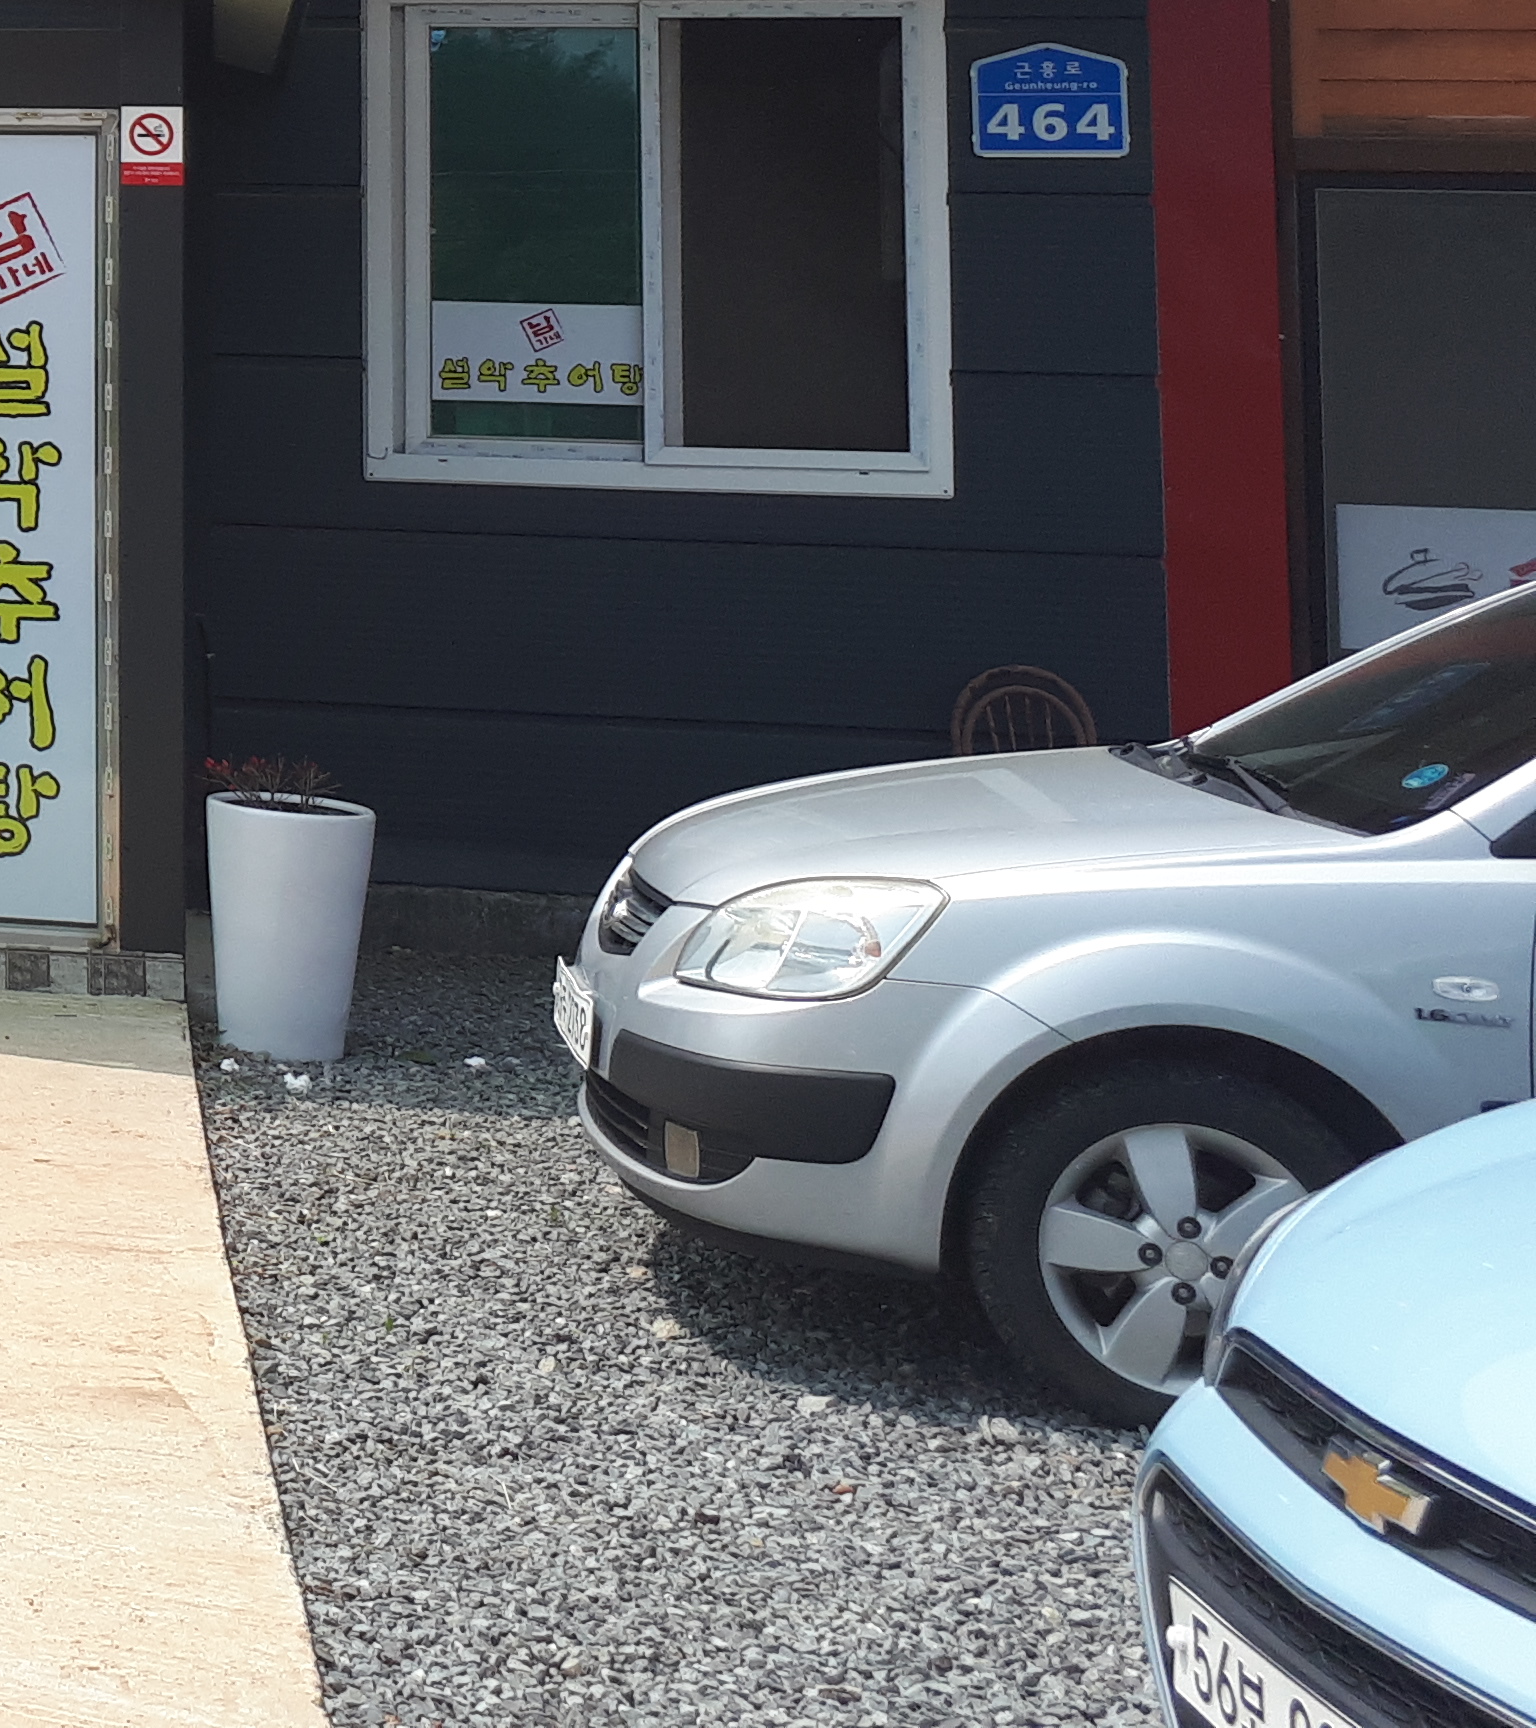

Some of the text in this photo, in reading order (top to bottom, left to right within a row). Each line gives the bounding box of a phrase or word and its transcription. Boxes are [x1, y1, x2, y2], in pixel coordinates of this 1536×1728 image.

[1013, 60, 1083, 79] 근흥로
[1004, 81, 1098, 91] Geunheung-ro
[986, 103, 1116, 141] 464
[439, 357, 644, 396] 설악추어탕
